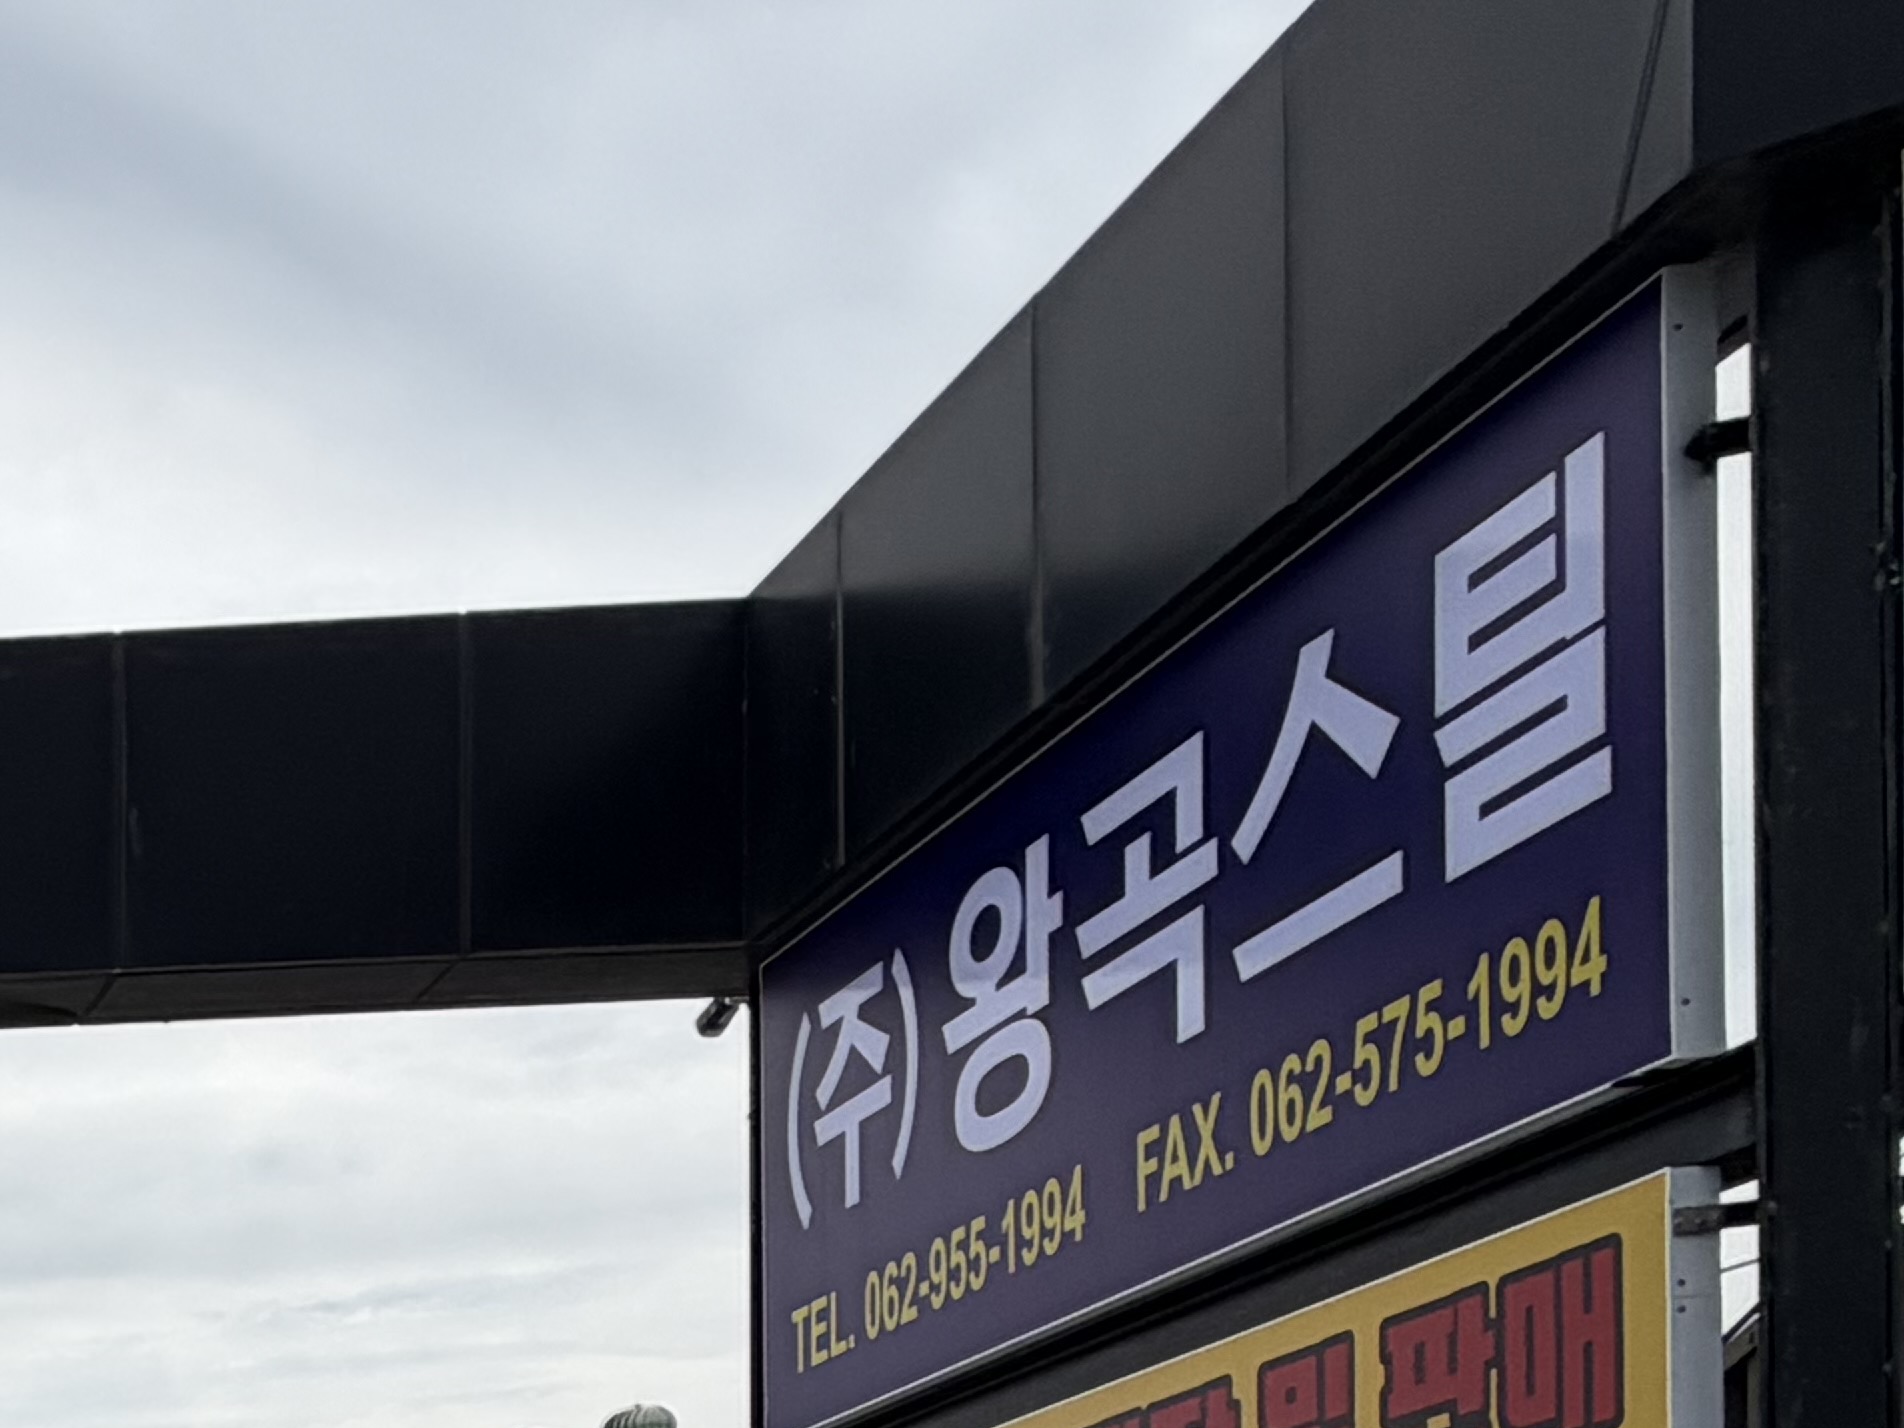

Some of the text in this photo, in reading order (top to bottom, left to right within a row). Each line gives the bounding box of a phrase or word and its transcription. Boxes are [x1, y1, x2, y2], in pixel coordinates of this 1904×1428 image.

[786, 430, 1613, 1229] (주)왕곡스틸
[791, 896, 1608, 1375] TEL. 062-955-1994 FAX. 062-575-1994
